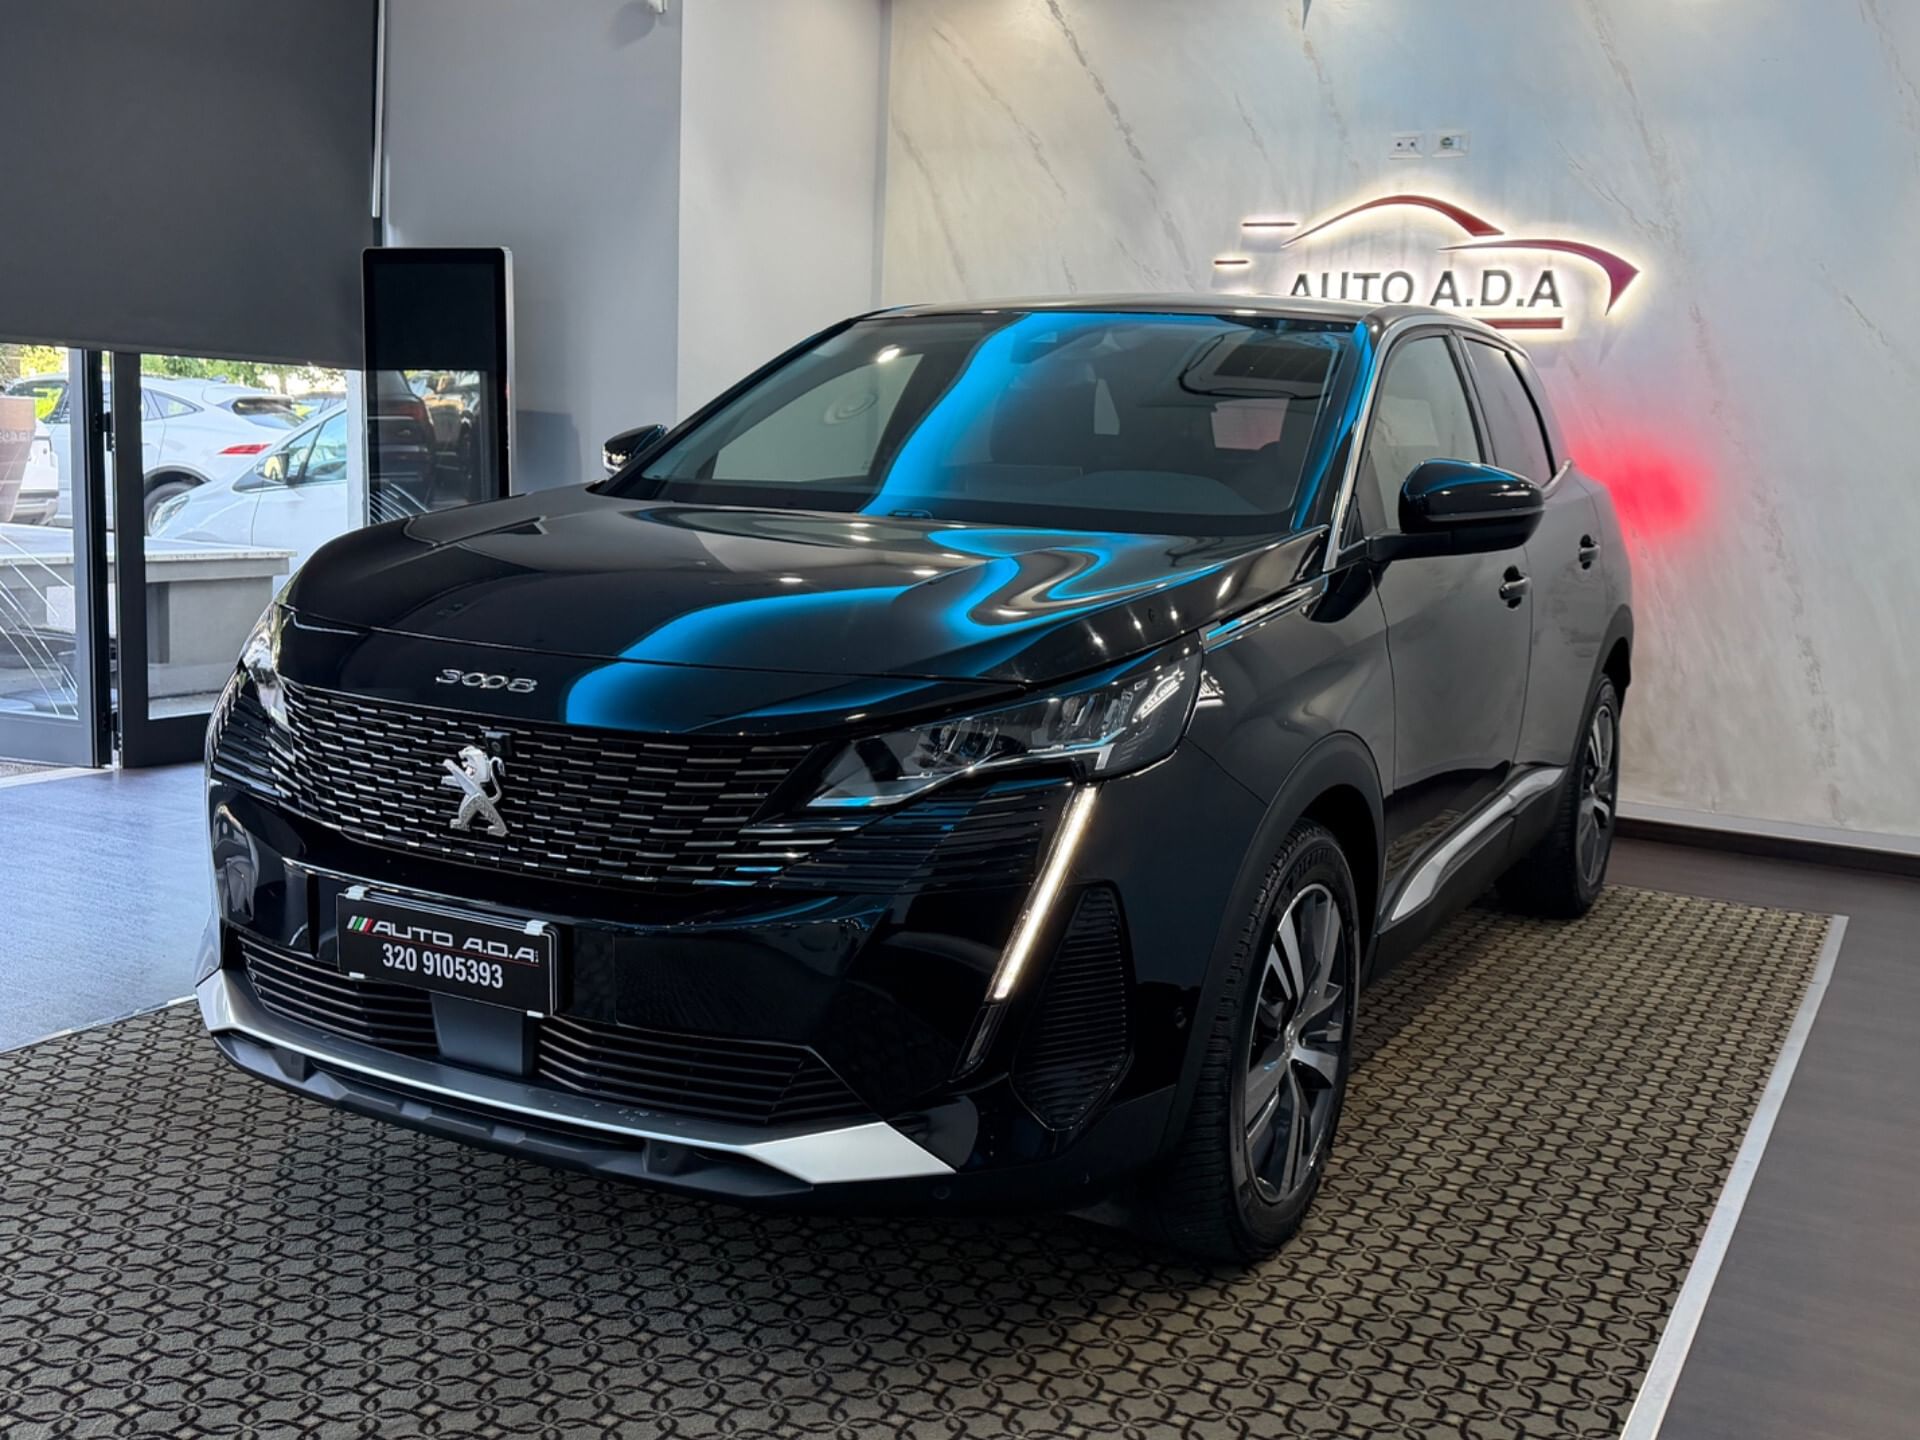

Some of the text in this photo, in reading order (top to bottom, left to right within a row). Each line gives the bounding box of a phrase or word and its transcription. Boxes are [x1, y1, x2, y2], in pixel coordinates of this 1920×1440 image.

[1290, 269, 1563, 308] AUTO A.D.A
[435, 669, 538, 693] 3008
[372, 920, 454, 947] AUTO
[382, 943, 504, 989] 320 9105393
